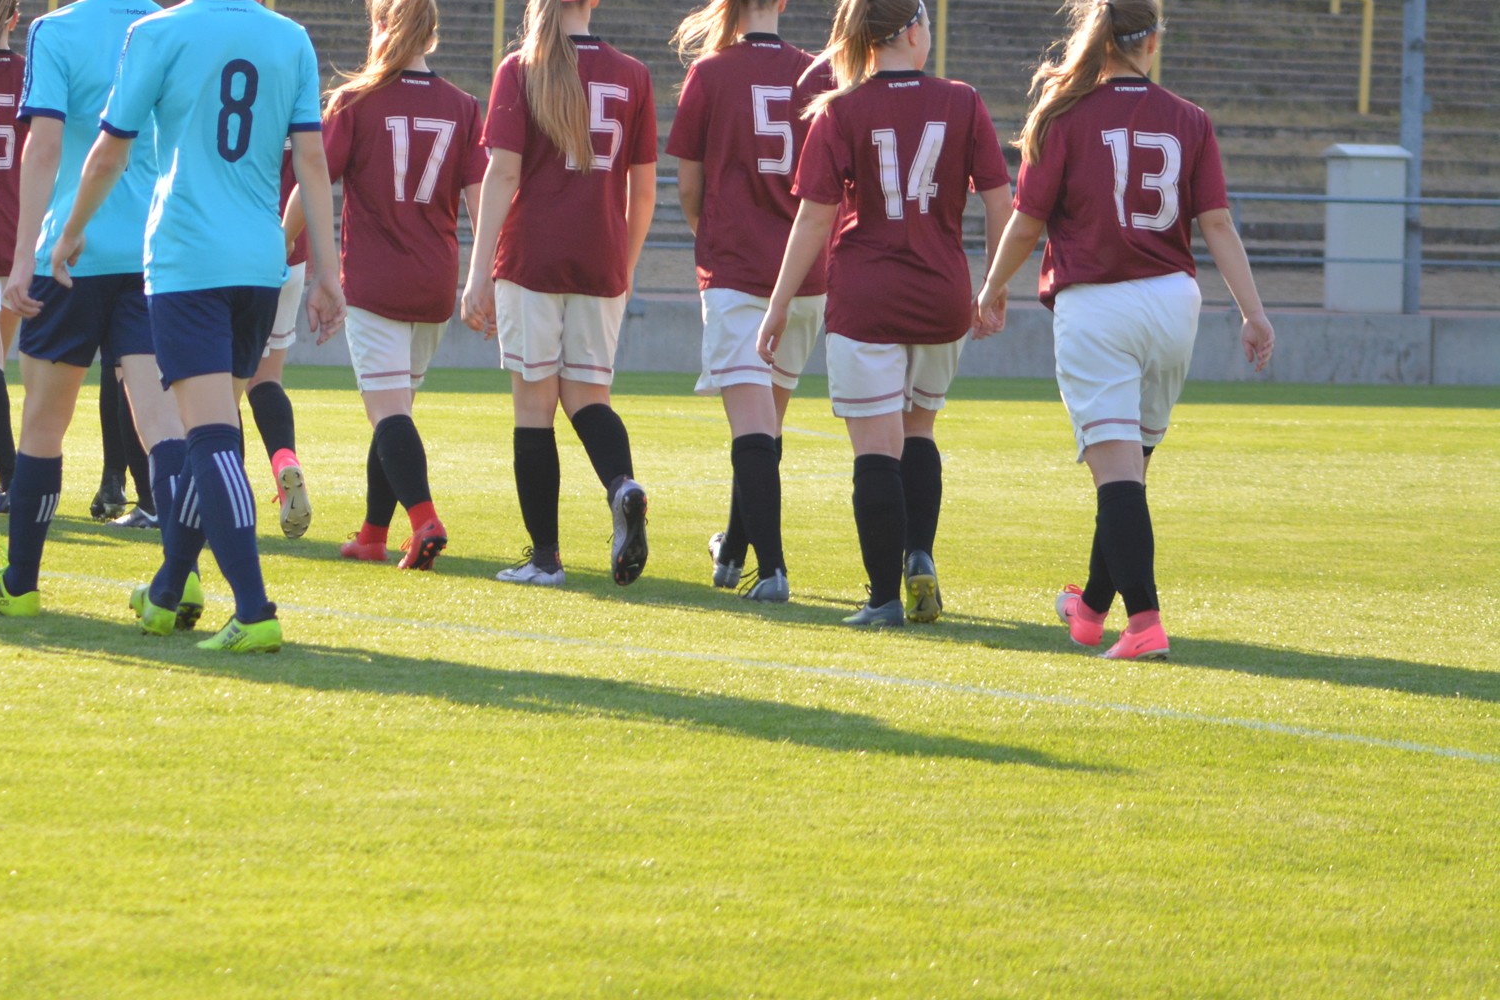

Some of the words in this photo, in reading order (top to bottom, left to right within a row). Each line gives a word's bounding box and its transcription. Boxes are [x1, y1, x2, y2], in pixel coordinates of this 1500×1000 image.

[217, 58, 259, 163] 8
[385, 116, 457, 204] 17
[751, 85, 793, 175] 5
[871, 121, 947, 220] 14
[1101, 128, 1182, 232] 13
